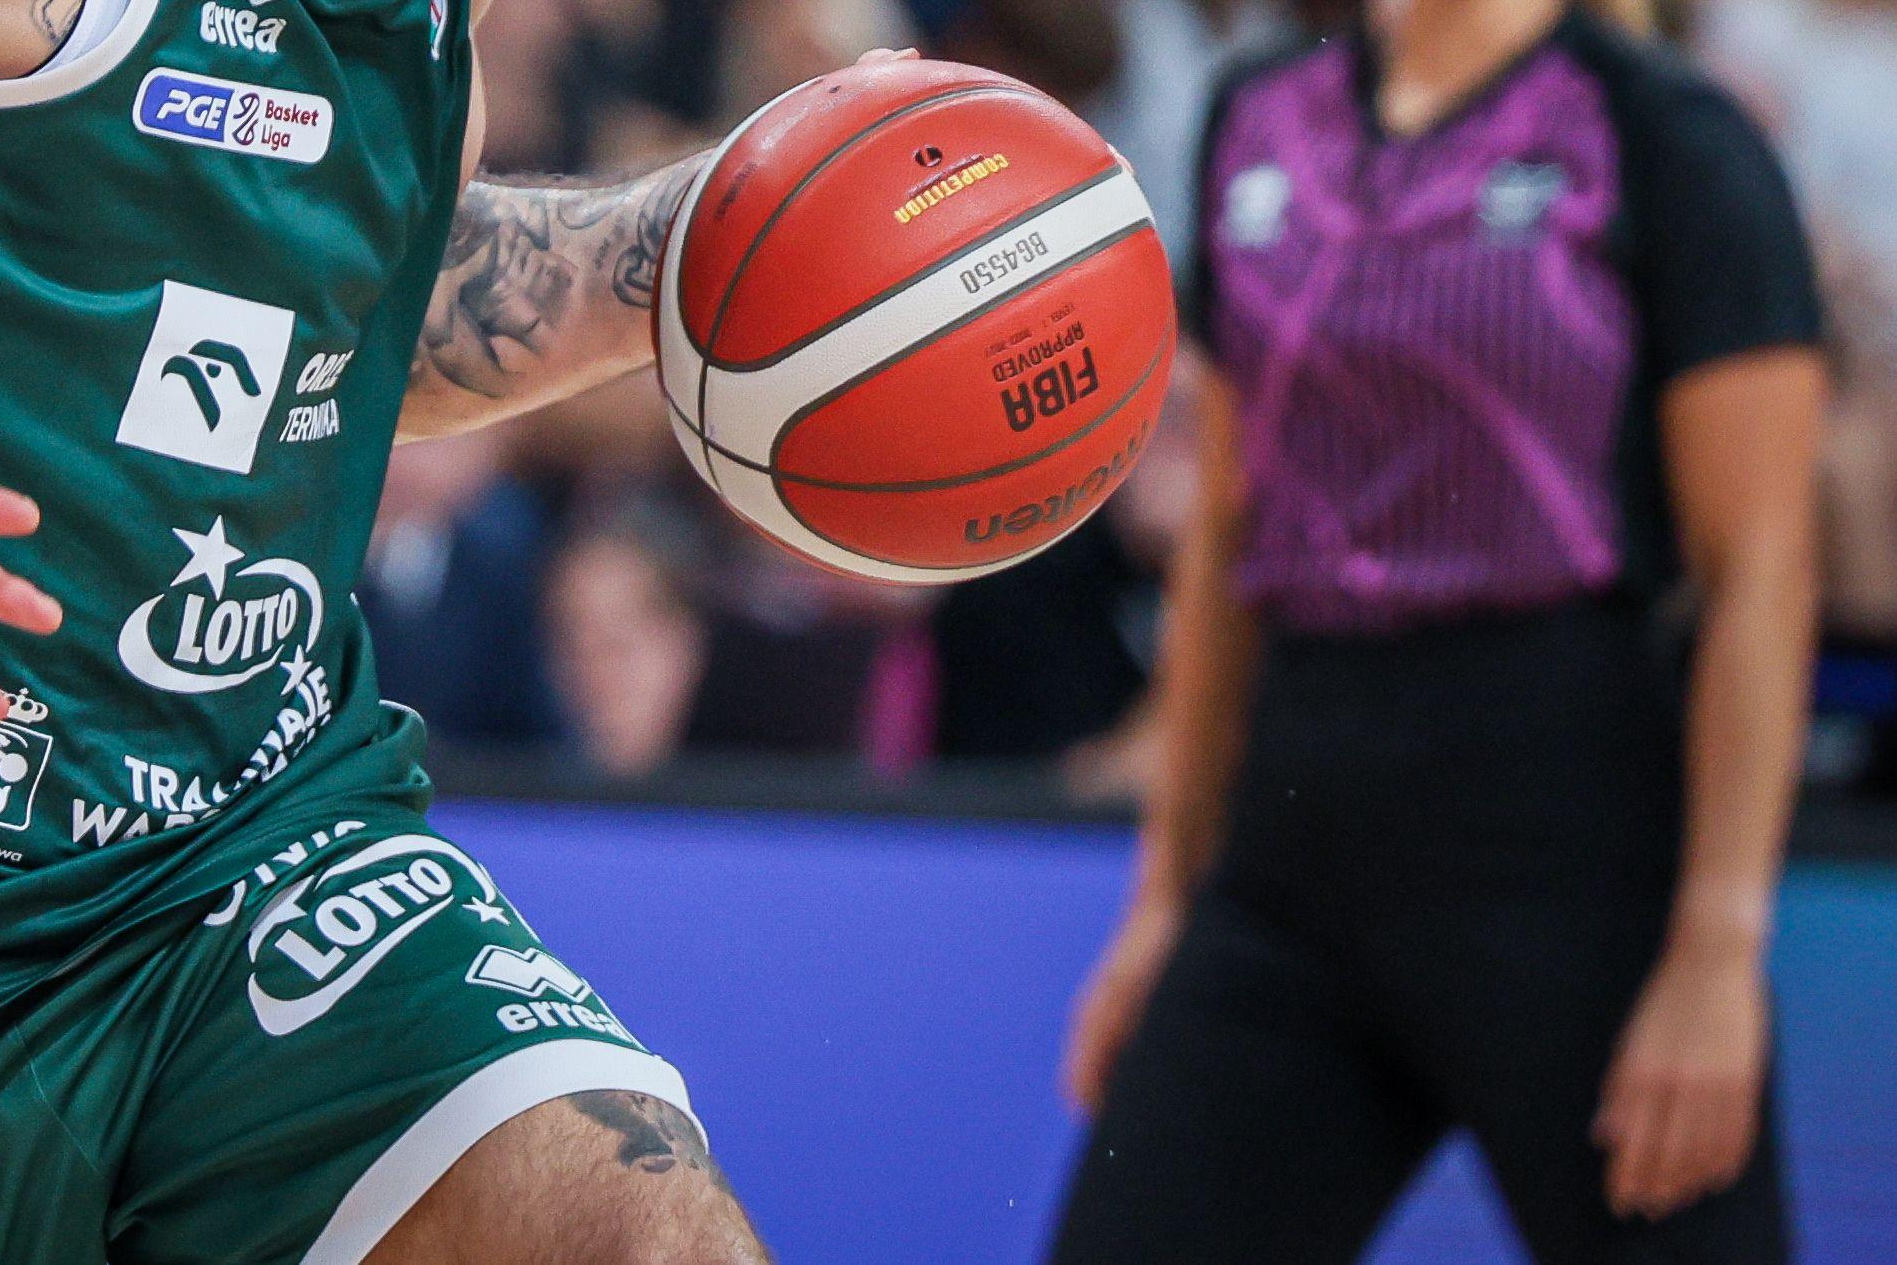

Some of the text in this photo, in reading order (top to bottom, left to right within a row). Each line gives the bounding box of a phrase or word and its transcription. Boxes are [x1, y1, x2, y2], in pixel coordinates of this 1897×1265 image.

[200, 1, 287, 54] errea
[156, 89, 226, 129] PGE
[261, 123, 291, 149] Liga
[265, 98, 319, 127] Basket
[894, 153, 1010, 223] COMPETITION
[959, 232, 1048, 294] BG4550
[992, 321, 1085, 382] APPROVED
[999, 346, 1098, 432] FIBA
[173, 587, 298, 666] LOTTO
[274, 857, 453, 982] LOTTO
[496, 1001, 635, 1042] errea
